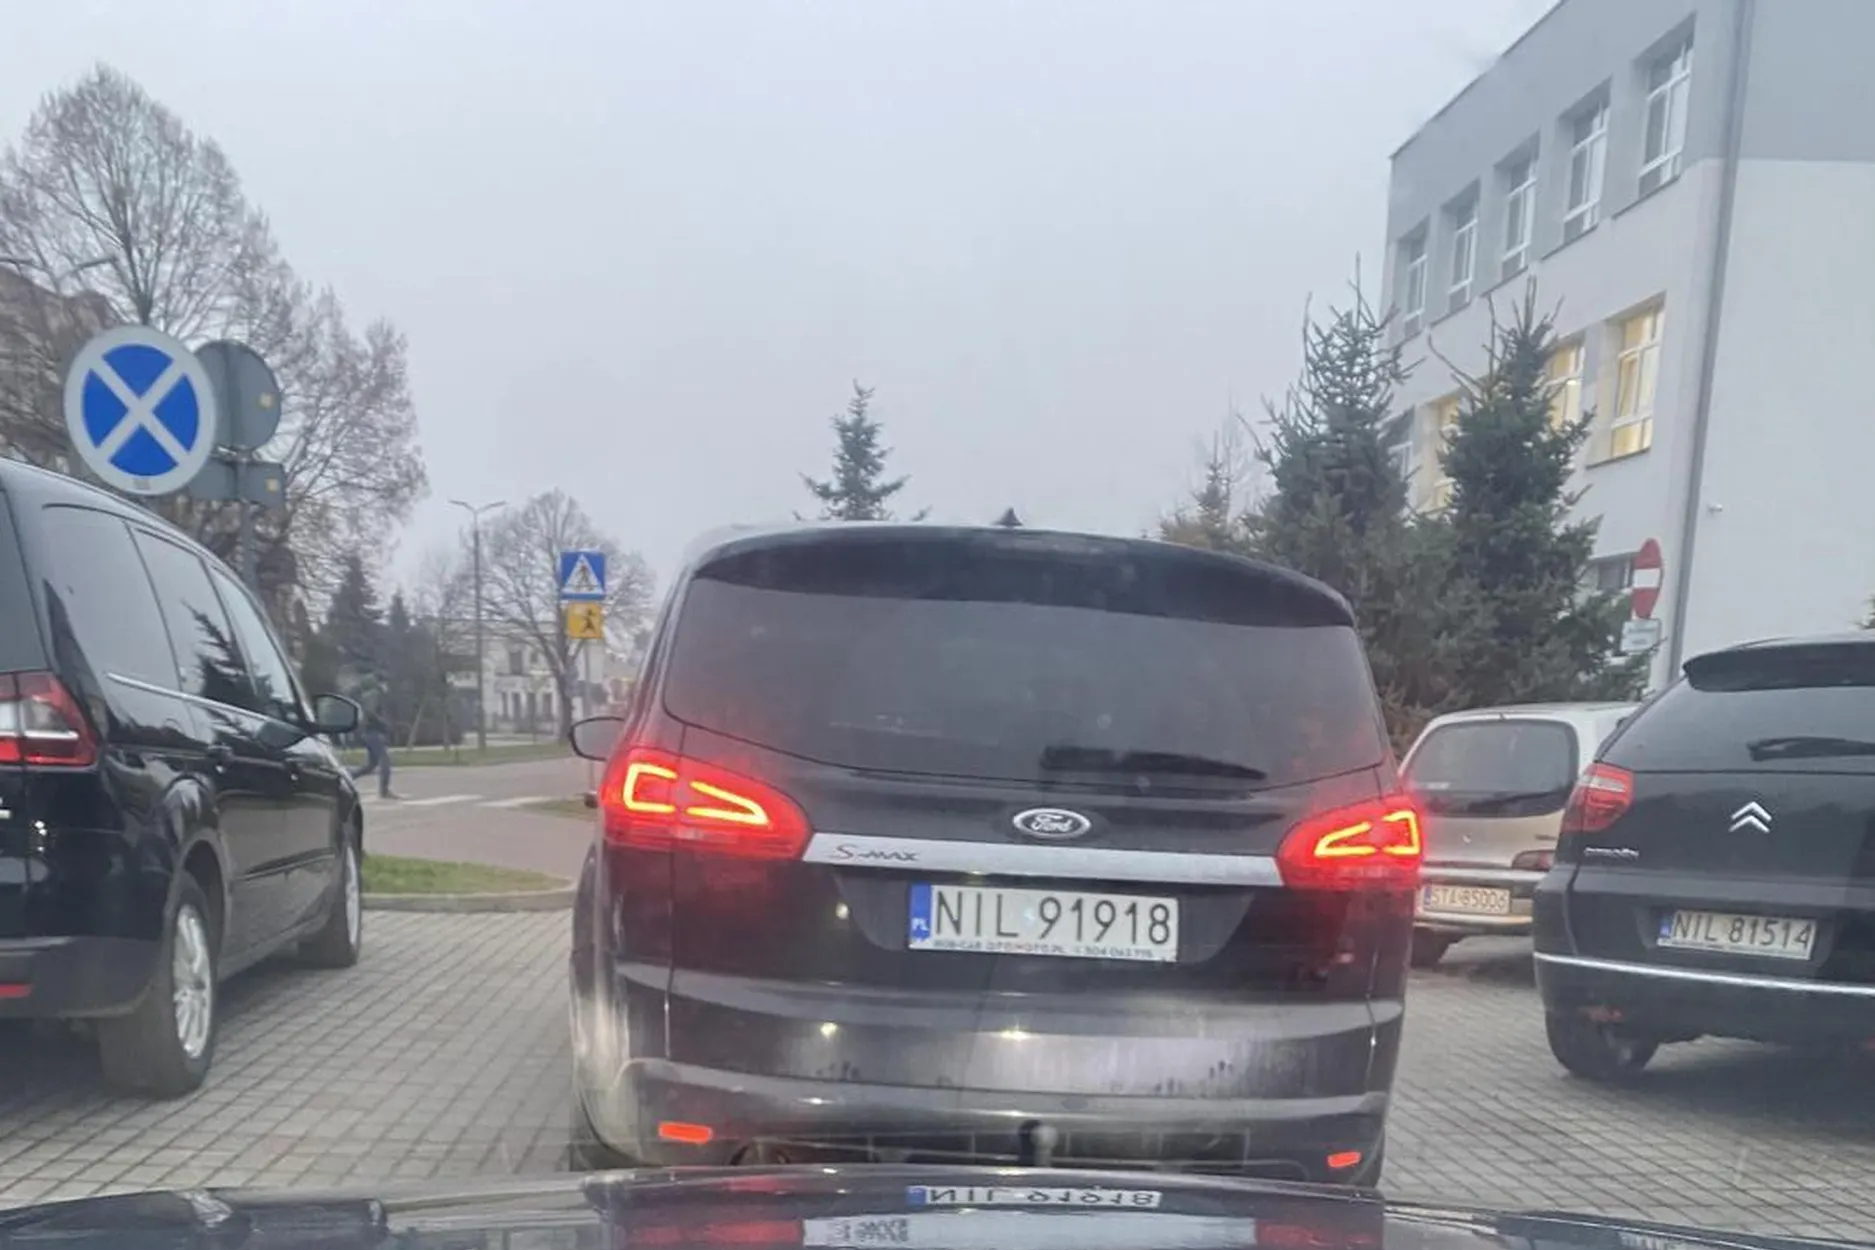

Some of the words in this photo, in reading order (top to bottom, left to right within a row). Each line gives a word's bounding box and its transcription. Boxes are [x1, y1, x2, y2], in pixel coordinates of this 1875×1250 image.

[1030, 813, 1074, 833] Ford
[936, 890, 1019, 938] NIL
[1039, 896, 1171, 946] 91918
[1673, 912, 1717, 942] NIL
[1728, 917, 1813, 950] 81514
